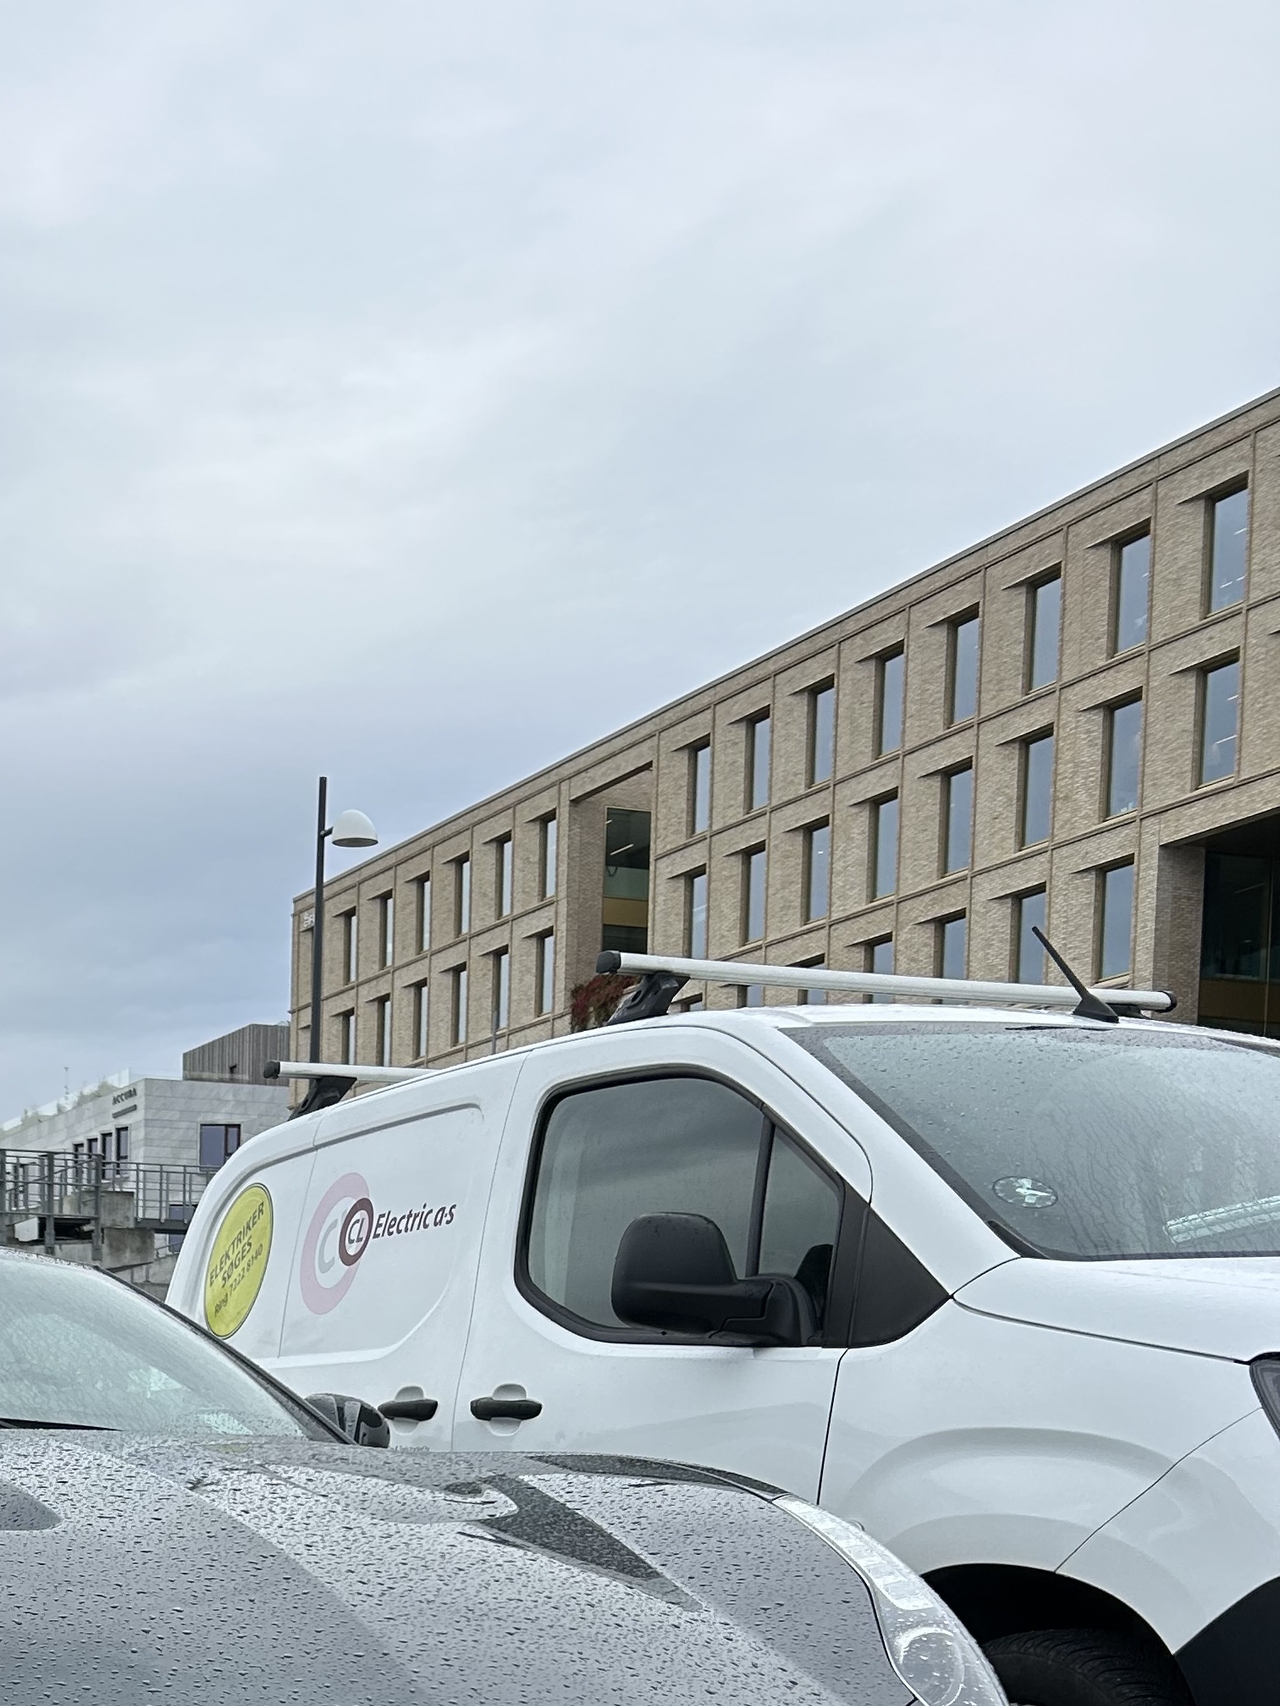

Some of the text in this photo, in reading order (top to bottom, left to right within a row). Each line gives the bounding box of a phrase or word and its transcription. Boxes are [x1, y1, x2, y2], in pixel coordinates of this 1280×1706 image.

[209, 1201, 264, 1288] ELEKTRIKER
[347, 1217, 365, 1244] CL
[372, 1203, 433, 1239] Electric
[221, 1235, 252, 1289] SØGES
